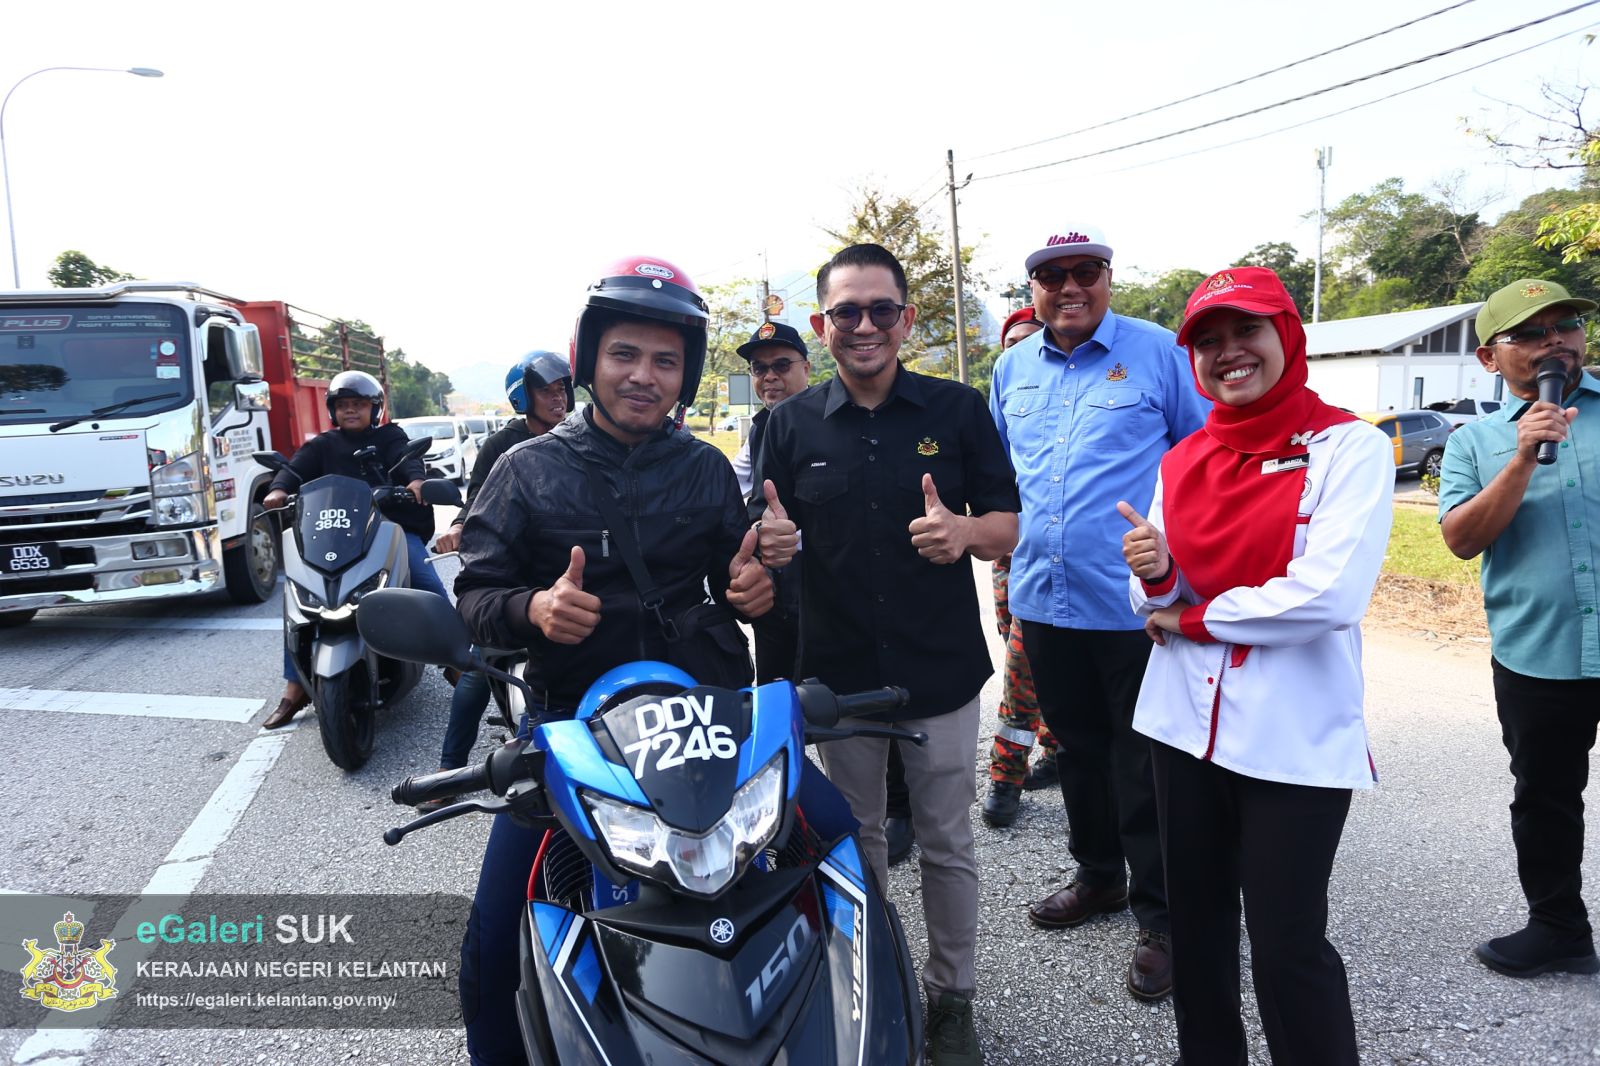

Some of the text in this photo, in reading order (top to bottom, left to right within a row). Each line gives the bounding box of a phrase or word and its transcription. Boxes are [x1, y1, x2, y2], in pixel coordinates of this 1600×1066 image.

[3, 318, 62, 328] PLUS
[0, 472, 65, 488] SUZU
[314, 517, 351, 531] 3843
[12, 545, 43, 559] DDX
[9, 556, 50, 571] 6533
[634, 695, 714, 740] DDV
[623, 724, 738, 780] 7246
[745, 913, 811, 1019] 150
